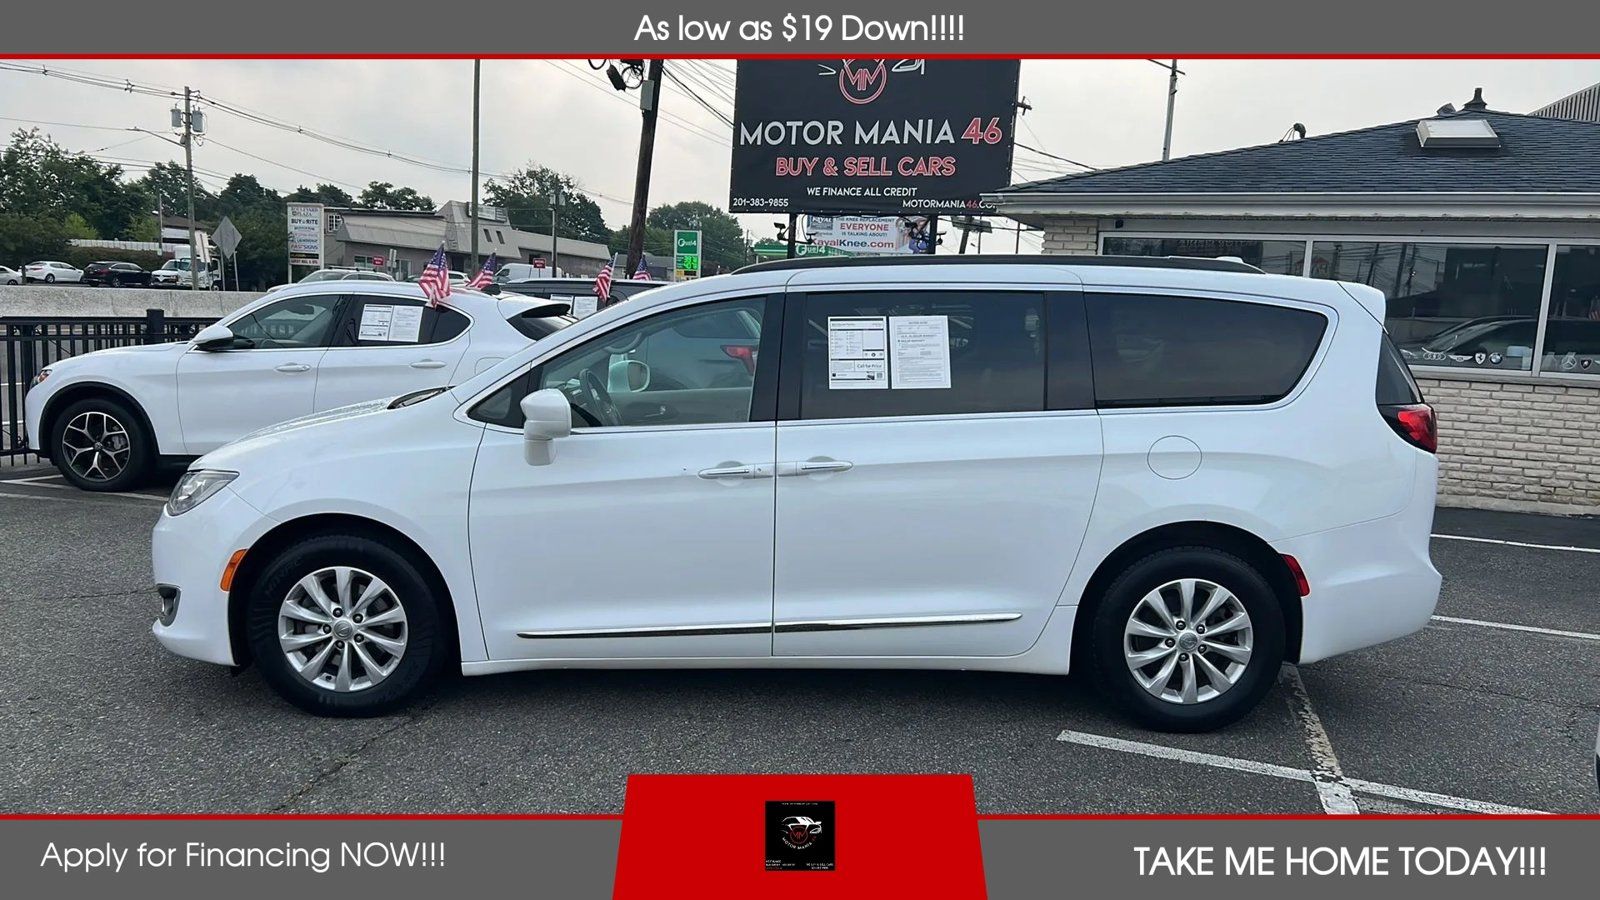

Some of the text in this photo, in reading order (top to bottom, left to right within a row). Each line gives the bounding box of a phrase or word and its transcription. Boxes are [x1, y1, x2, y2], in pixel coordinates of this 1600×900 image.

[740, 117, 1003, 146] MOTOR MANIA 46
[776, 156, 956, 176] BUY & SELL CARS
[806, 187, 918, 196] WE FINANCE ALL CREDIT
[732, 198, 789, 207] 201-383-9855
[840, 223, 889, 231] EVERYONE
